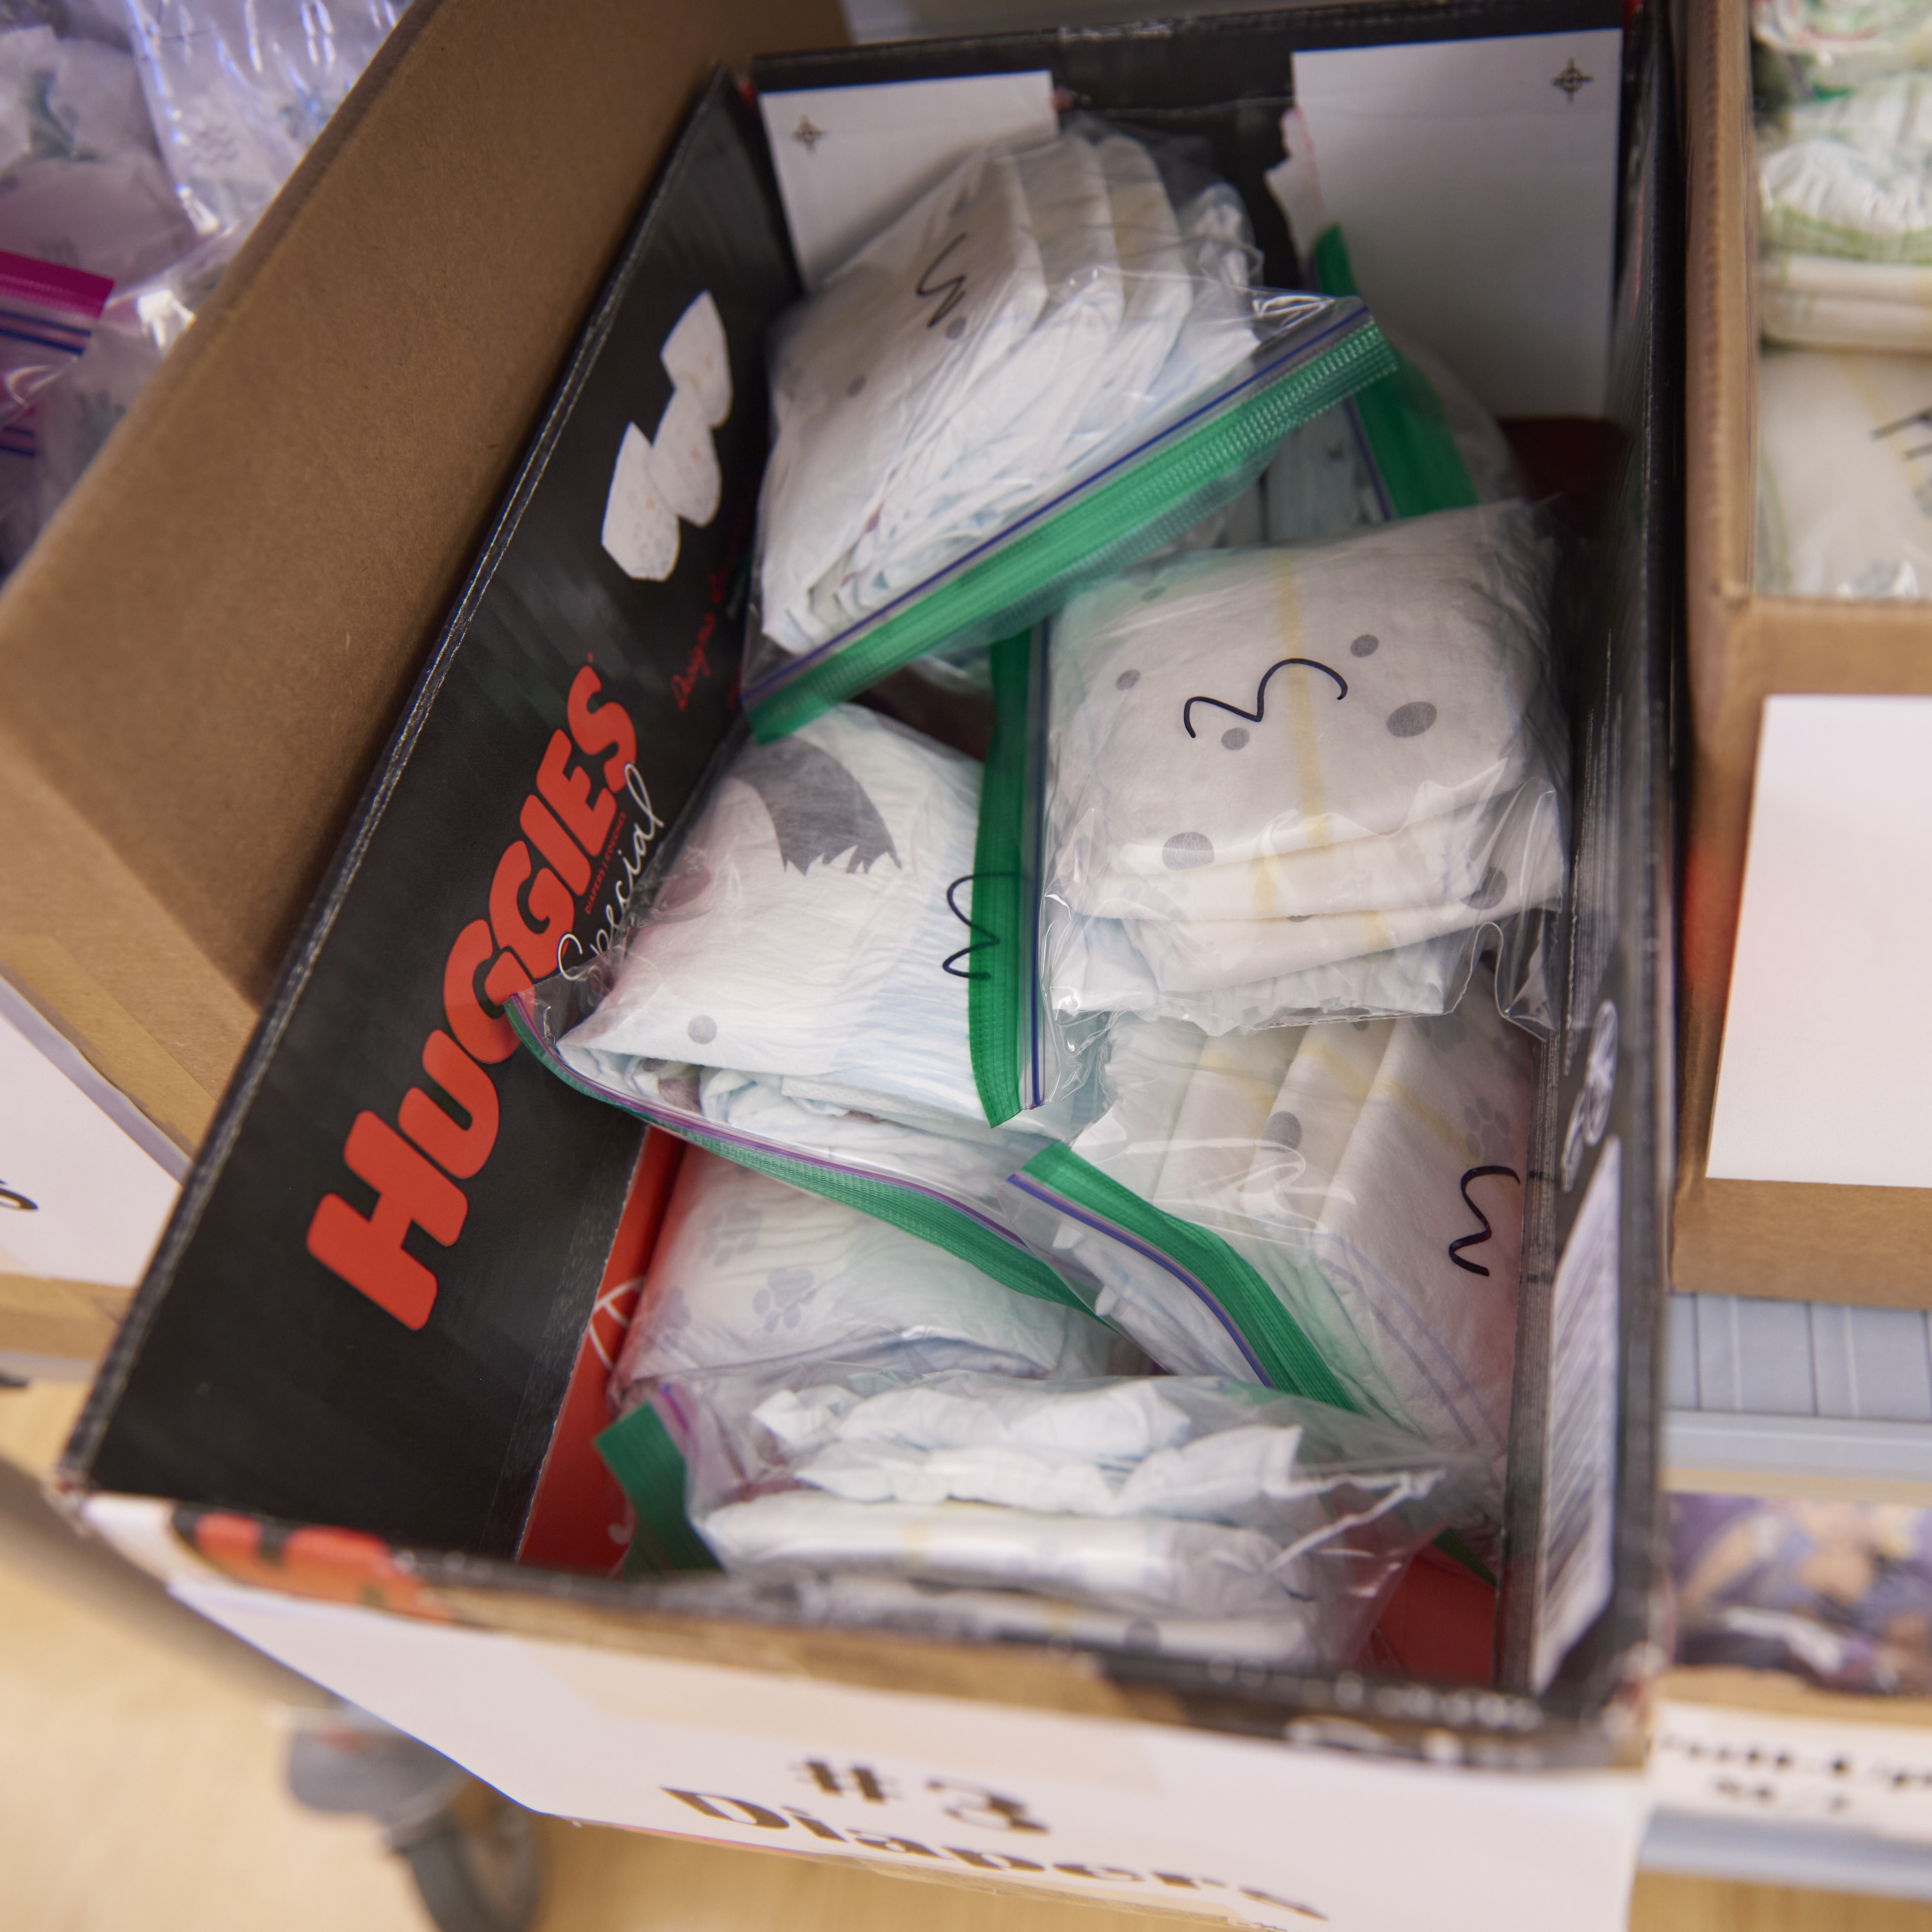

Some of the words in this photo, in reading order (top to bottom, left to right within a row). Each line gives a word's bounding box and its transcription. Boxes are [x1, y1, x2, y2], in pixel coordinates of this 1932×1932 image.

[1184, 658, 1348, 738] 3
[557, 762, 665, 981] Special
[585, 867, 605, 914] DIAPERS
[605, 811, 627, 861] COUCHES
[306, 665, 637, 1331] HUGGIES
[1449, 1165, 1520, 1277] 3
[659, 1786, 1330, 1923] Diapers
